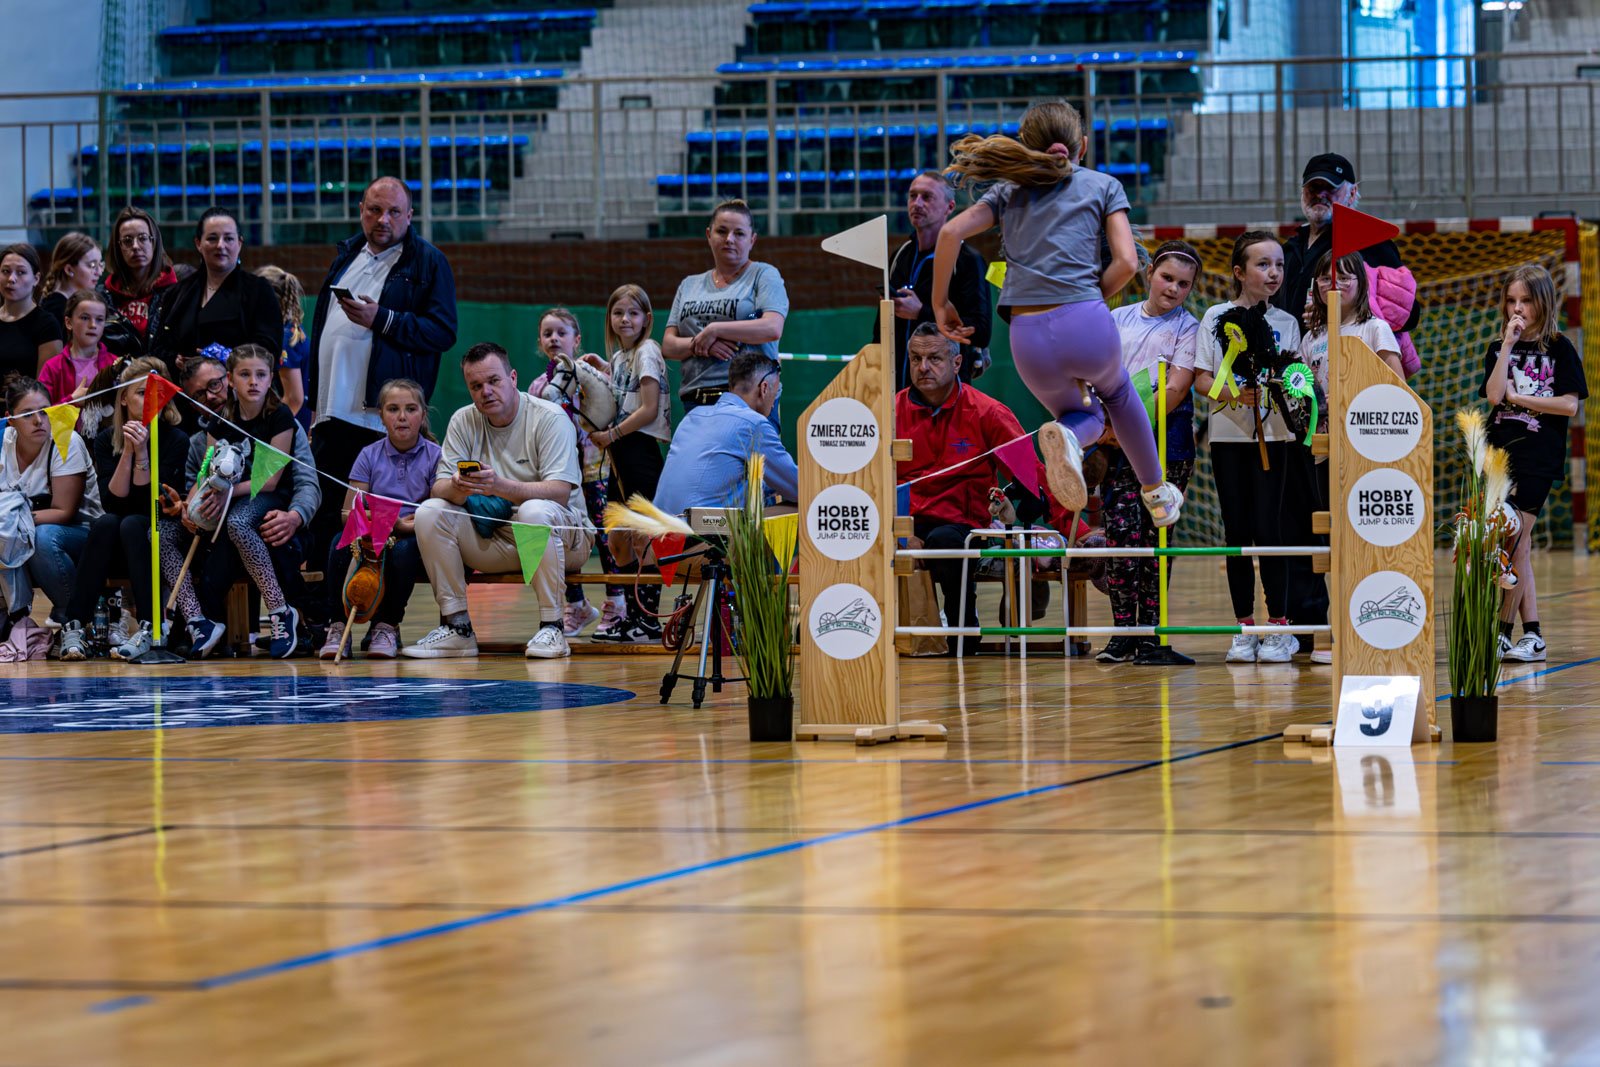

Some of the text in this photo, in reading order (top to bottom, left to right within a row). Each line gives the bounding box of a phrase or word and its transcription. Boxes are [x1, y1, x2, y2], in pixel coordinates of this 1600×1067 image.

[680, 299, 739, 321] BROOKLYN
[1350, 412, 1418, 425] ZMIERZ CZAS
[811, 424, 875, 437] ZMIERZ CZAS
[1359, 490, 1413, 502] HOBBY
[818, 505, 869, 517] HOBBY
[1359, 504, 1414, 516] HORSE
[818, 519, 869, 531] HORSE
[1359, 693, 1394, 737] 9
